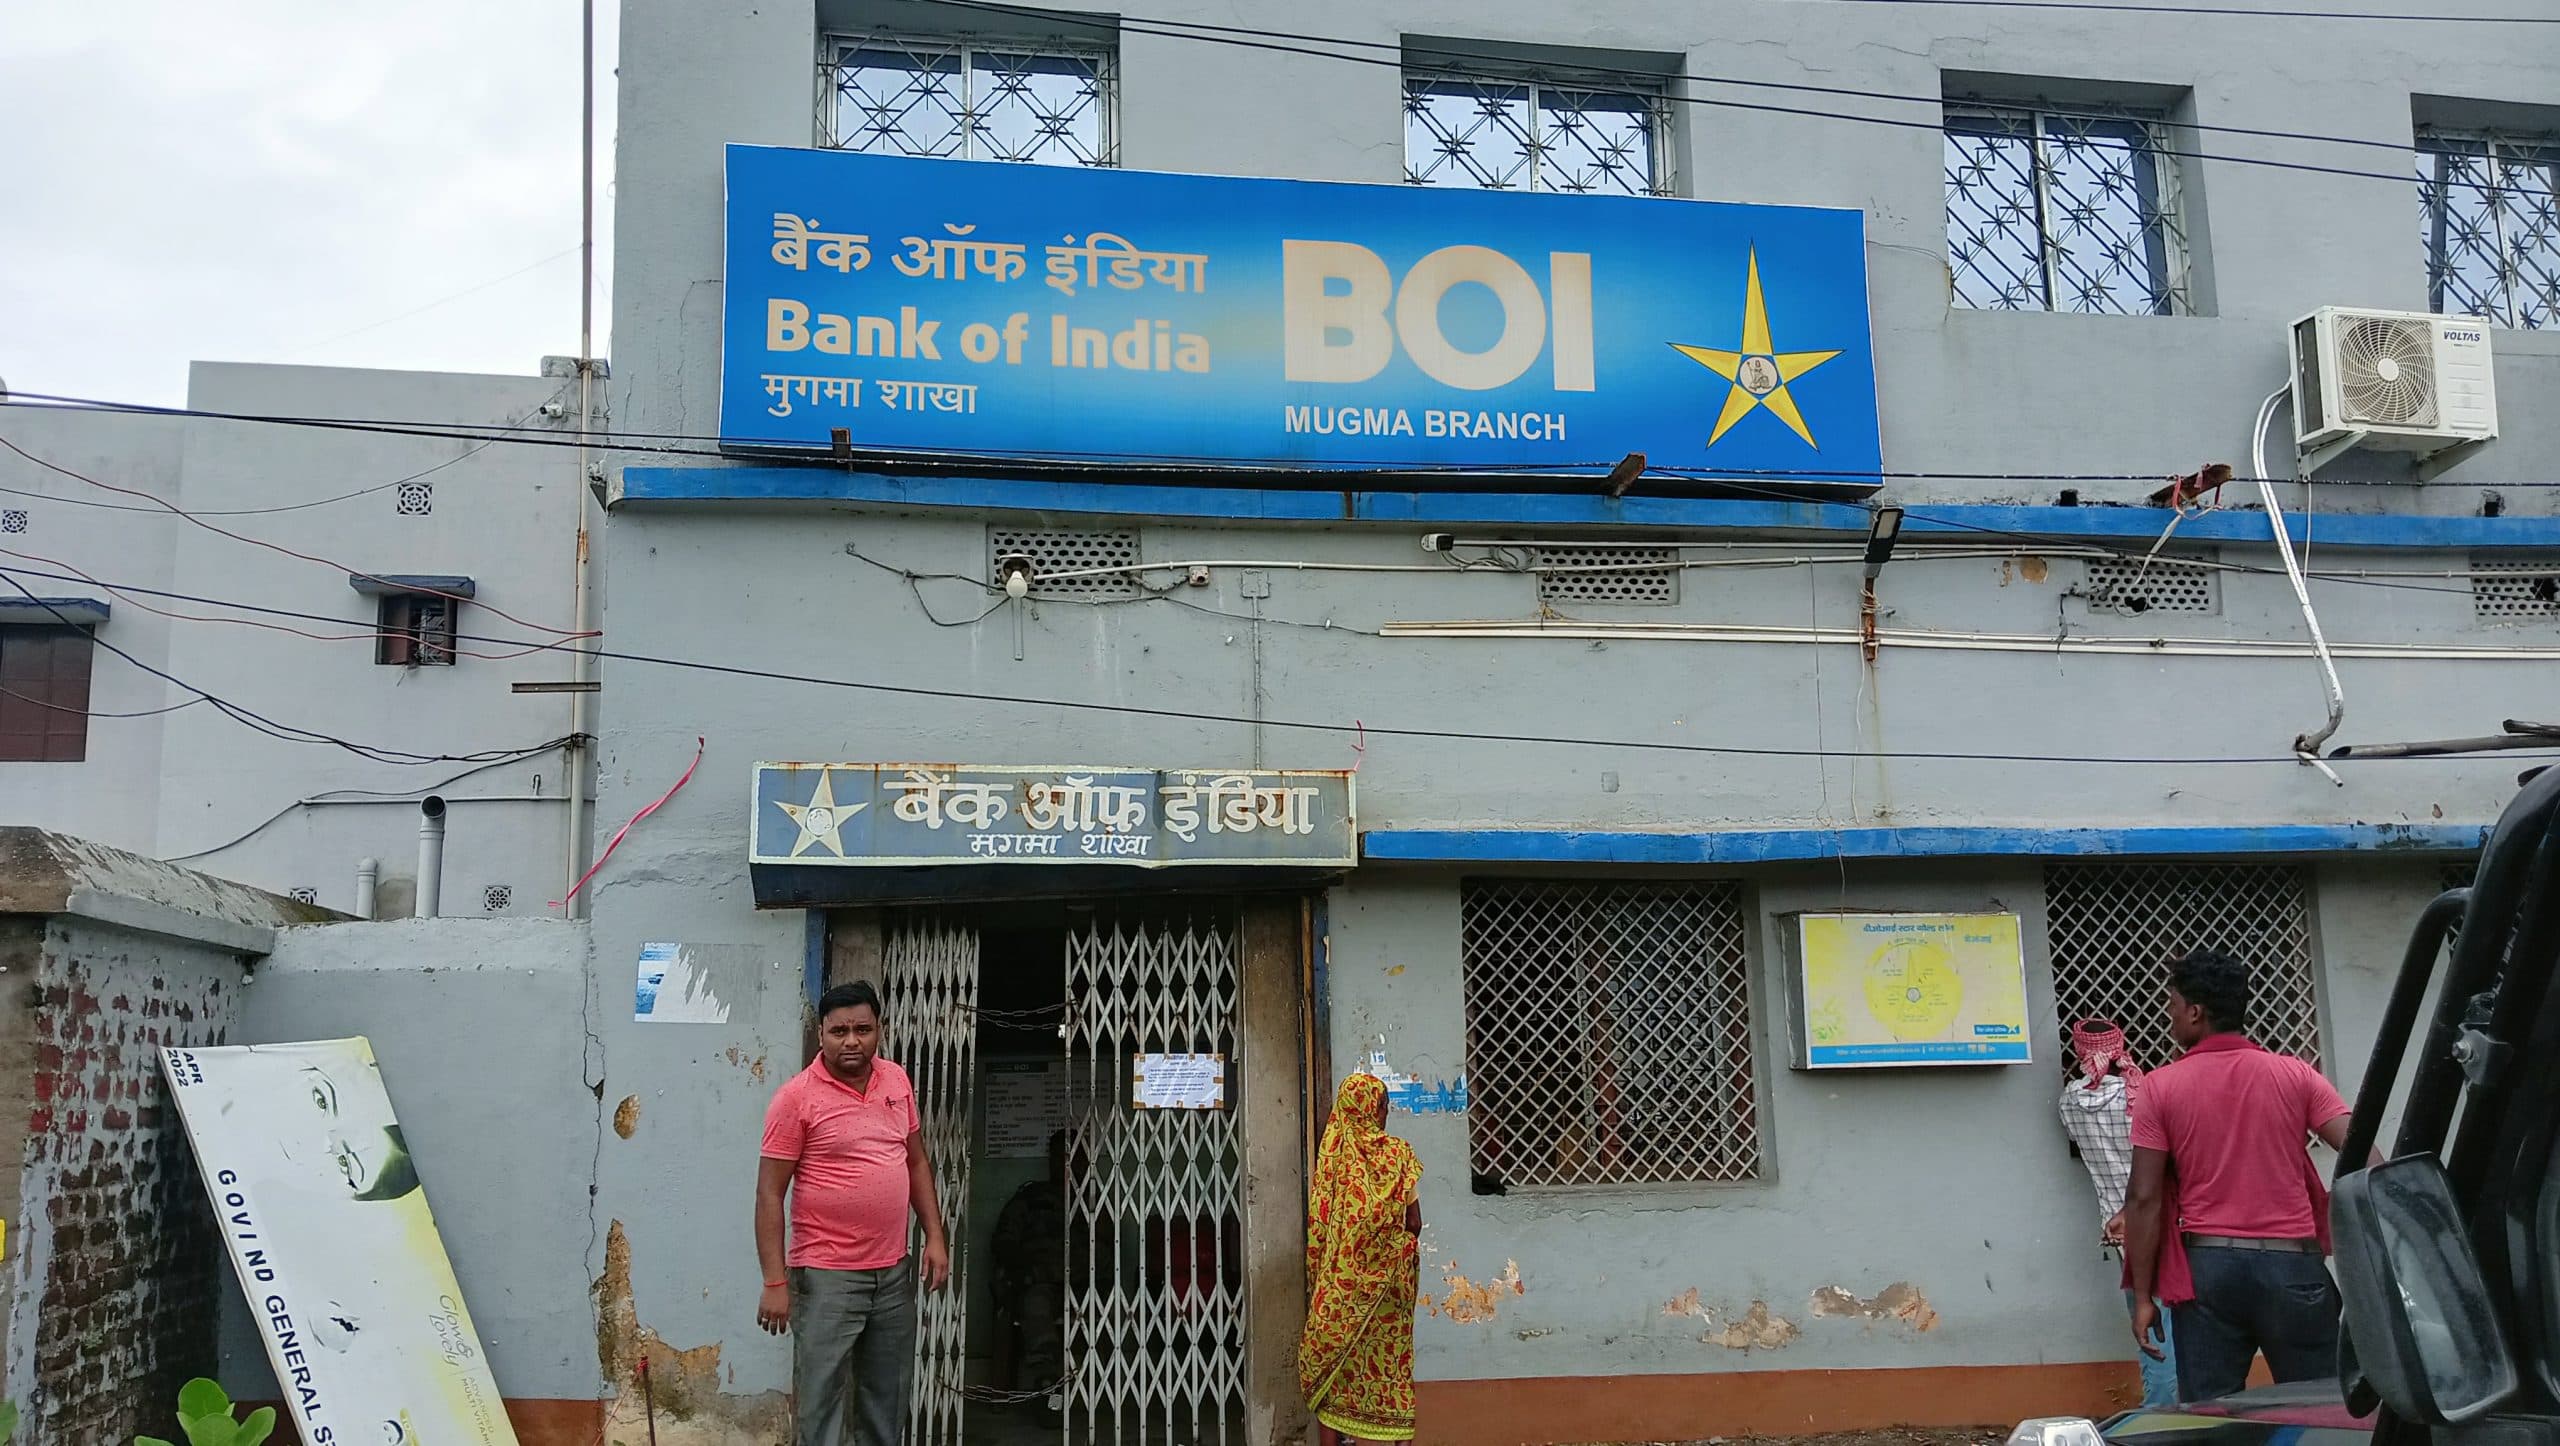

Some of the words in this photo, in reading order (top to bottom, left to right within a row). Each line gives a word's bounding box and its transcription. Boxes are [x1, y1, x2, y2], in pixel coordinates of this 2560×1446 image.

[772, 213, 871, 273] बैंक
[892, 223, 1026, 283] ऑफ
[1045, 232, 1208, 297] इंडिया
[767, 298, 942, 361] Bank
[960, 312, 1029, 366] of
[1051, 315, 1210, 374] India
[1282, 239, 1596, 392] BOI
[2443, 331, 2481, 342] VOLTAS
[761, 374, 862, 417] मुगमा
[876, 379, 977, 414] शाखा
[1285, 405, 1415, 437] MUGMA
[1425, 409, 1566, 441] BRANCH
[883, 770, 1014, 831] बैंक
[1159, 775, 1320, 843] इंडिया
[966, 833, 1062, 859] मुगमा
[1080, 832, 1152, 856] शाखा
[166, 1050, 189, 1087] 2022
[183, 1052, 203, 1084] APR
[217, 1168, 275, 1282] GOVIND
[265, 1294, 321, 1421] GENERAL
[313, 1426, 336, 1446] S
[429, 1314, 460, 1366] Lovely
